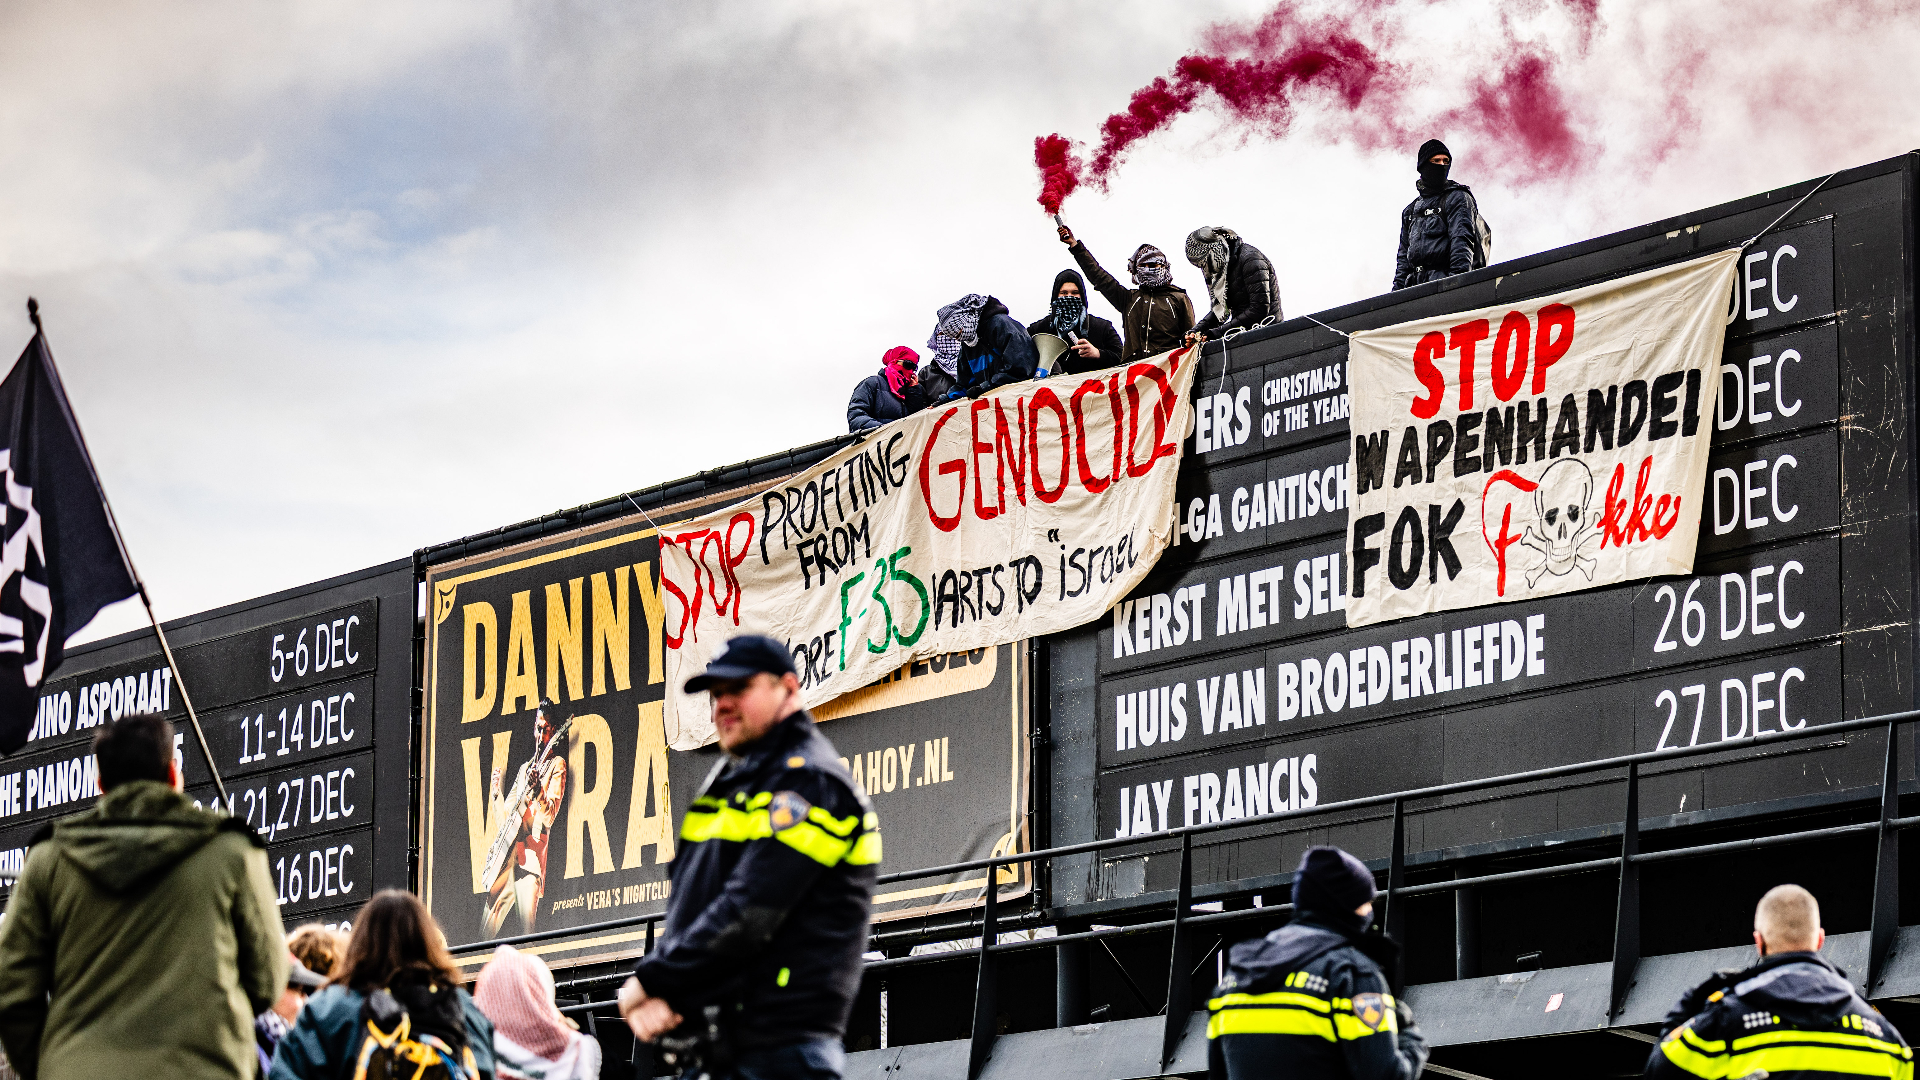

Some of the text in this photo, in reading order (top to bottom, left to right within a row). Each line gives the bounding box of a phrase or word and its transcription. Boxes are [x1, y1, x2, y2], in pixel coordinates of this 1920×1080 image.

[1409, 302, 1576, 419] STOP
[1717, 349, 1802, 431] DEC
[1184, 386, 1251, 455] ERS
[1263, 363, 1341, 407] CHRISTMAS
[1263, 410, 1281, 438] OF
[1284, 402, 1309, 433] THE
[760, 431, 911, 565] PROFITING
[1713, 454, 1799, 536] DEC
[659, 512, 755, 650] STOP
[796, 512, 872, 590] FROM
[1353, 498, 1466, 598] FOK
[461, 560, 665, 724] DANNY
[785, 630, 837, 690] ORE
[839, 546, 930, 671] F-35
[1009, 554, 1044, 614] TO
[1113, 553, 1347, 659] KERST MET SEL
[1653, 560, 1805, 653] 26 DEC
[271, 615, 360, 683] 5-6 DEC
[1116, 614, 1545, 752] HUIS VAN BROEDERLIEFDE
[75, 666, 173, 731] ASPORAAT
[238, 691, 356, 766] 11-14 DEC
[1655, 667, 1806, 752] 27 DEC
[25, 753, 104, 812] PIANOM
[310, 767, 355, 824] DEC
[838, 736, 954, 796] AHOY.NL
[1115, 753, 1318, 838] JAY FRANCIS
[275, 844, 354, 906] 16 DEC
[586, 886, 621, 911] VERA'S
[623, 879, 672, 905] NIGHTCLU
